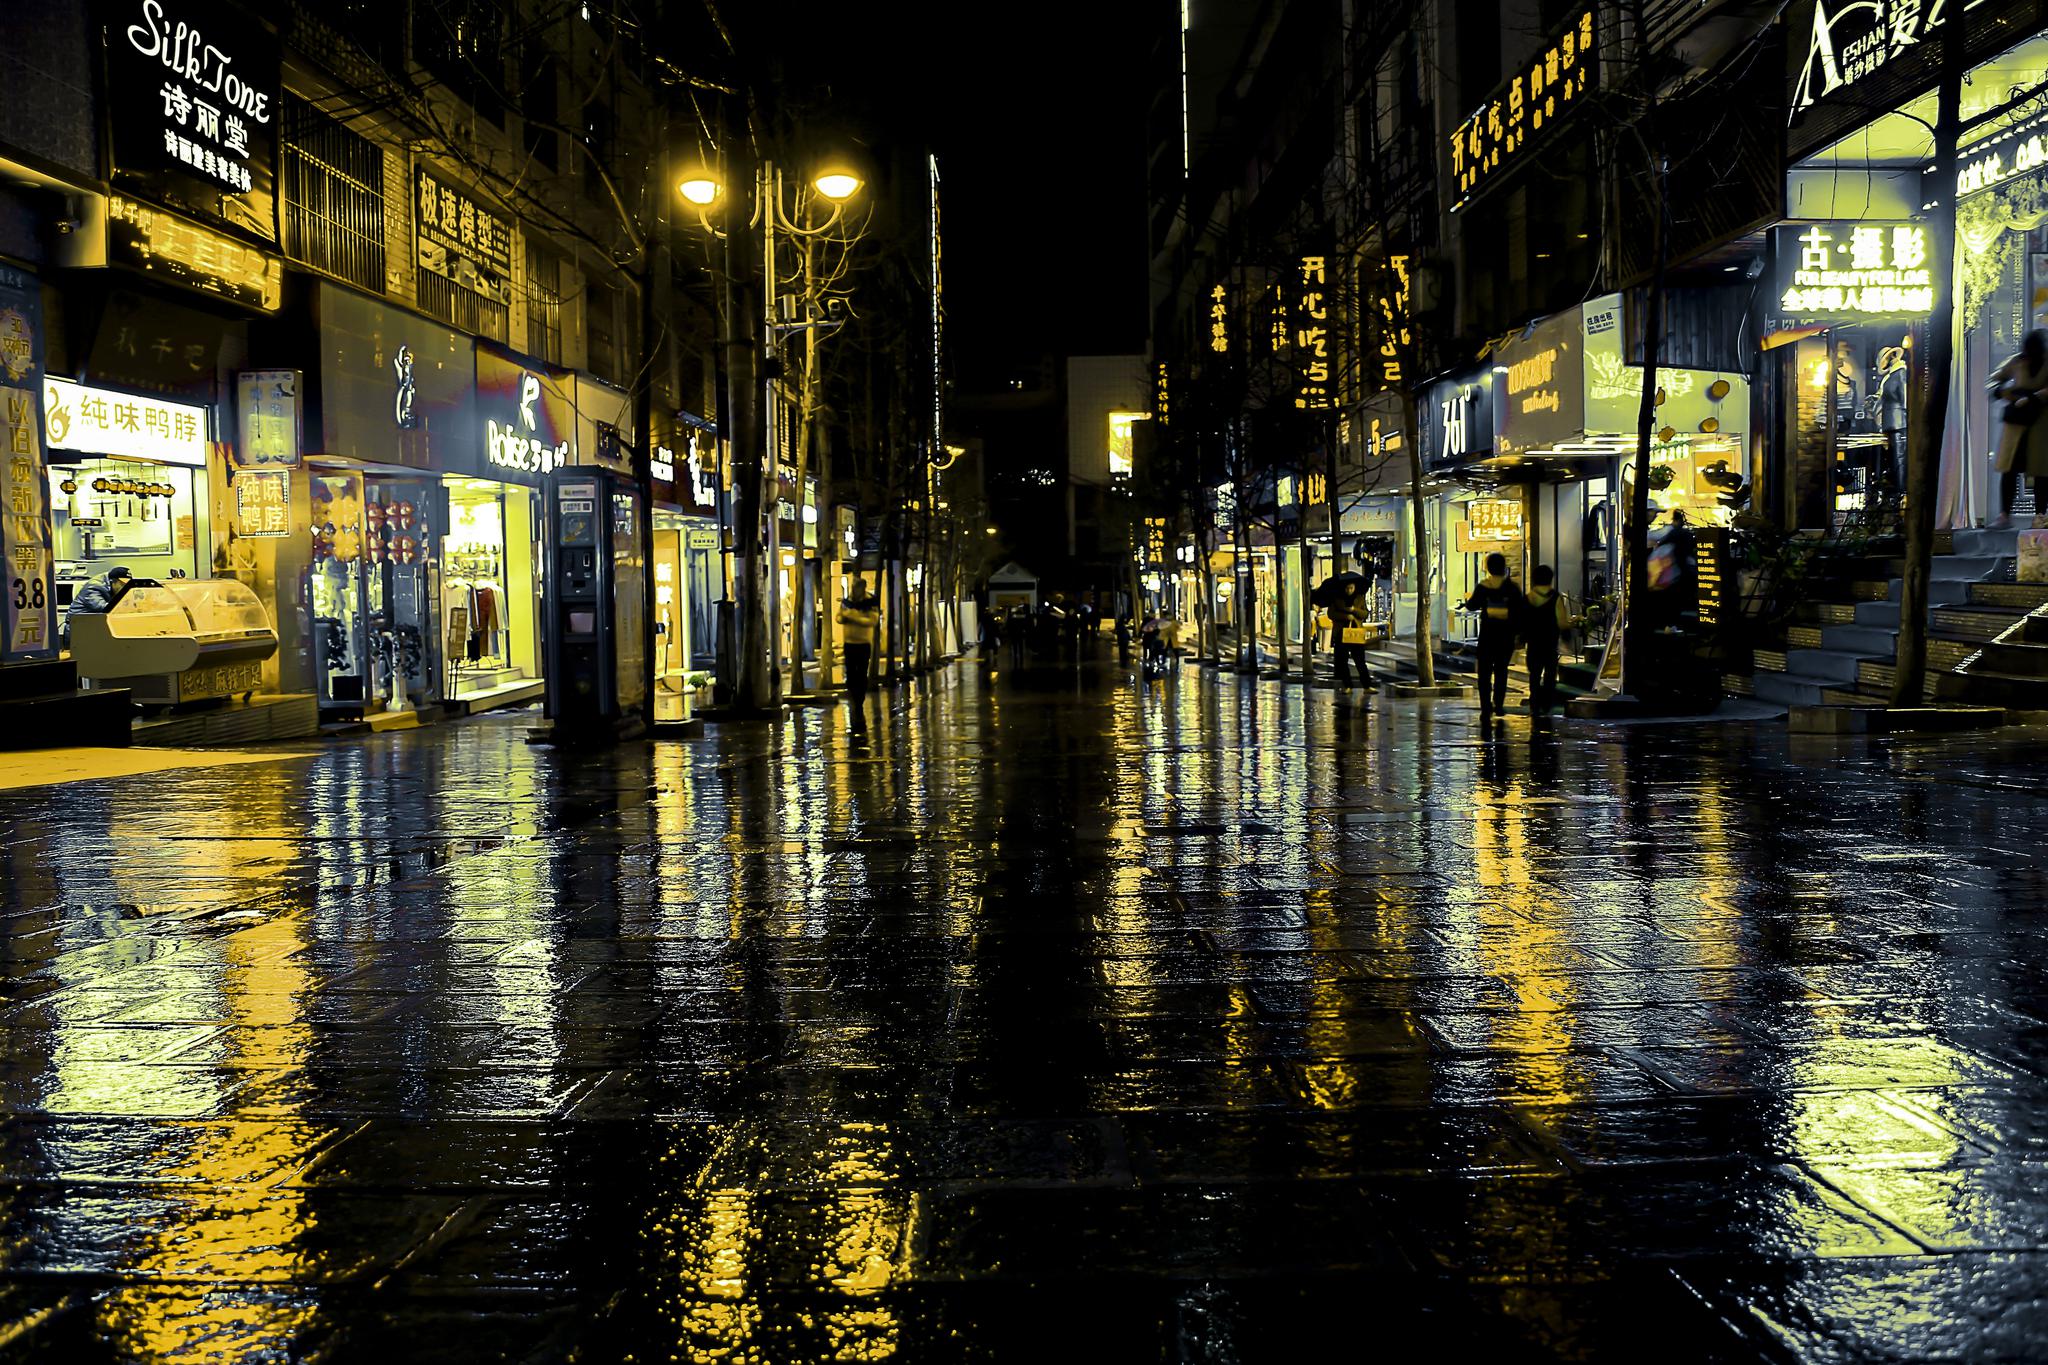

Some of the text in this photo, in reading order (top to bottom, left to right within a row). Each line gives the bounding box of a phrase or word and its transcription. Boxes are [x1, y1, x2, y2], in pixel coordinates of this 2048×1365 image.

[160, 82, 250, 158] 诗丽堂
[419, 171, 494, 256] 极速模型
[79, 393, 198, 443] 纯味鸭脖
[241, 475, 283, 503] 纯味
[241, 505, 284, 532] 鸭脖
[13, 577, 45, 609] 3.8
[20, 617, 42, 644] 元
